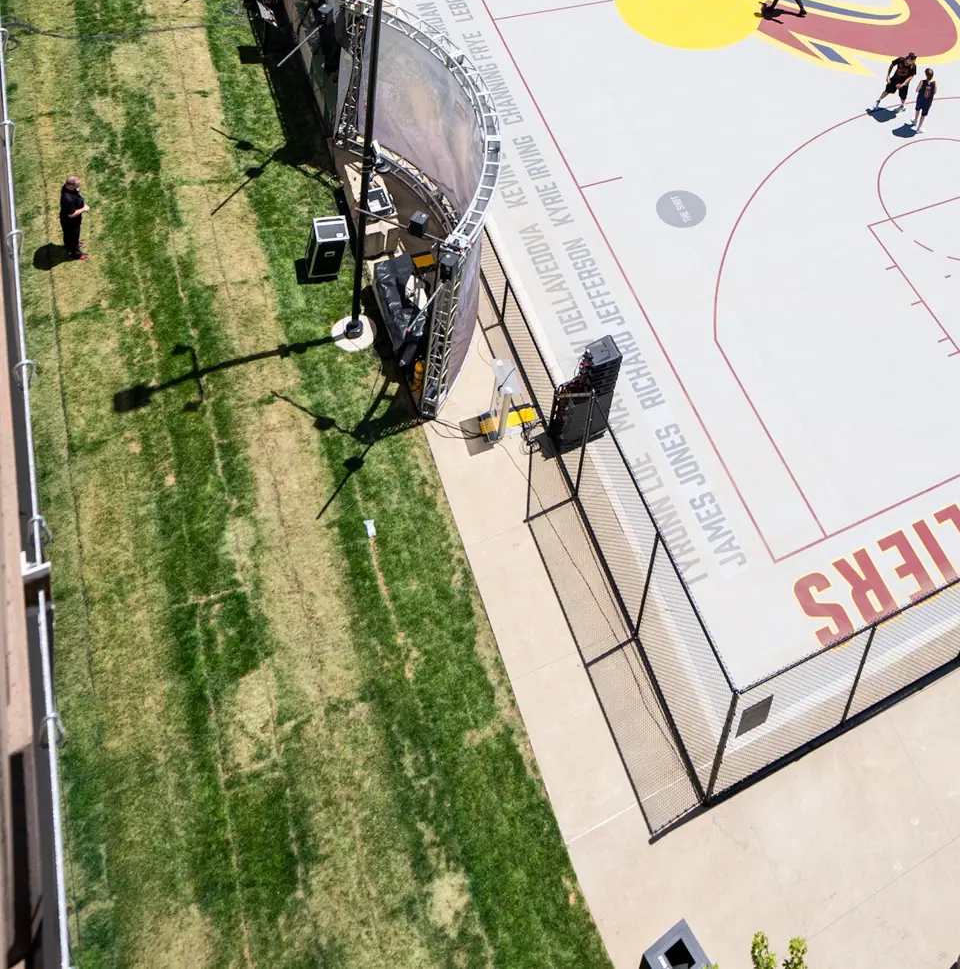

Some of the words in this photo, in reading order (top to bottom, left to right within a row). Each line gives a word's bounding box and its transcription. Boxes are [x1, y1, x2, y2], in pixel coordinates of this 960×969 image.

[462, 31, 493, 61] FRYE
[477, 62, 524, 126] CHANNING
[513, 134, 551, 181] IRVING
[535, 181, 574, 227] KYRIE
[518, 222, 589, 336] DELLAVEDOVA
[562, 236, 625, 327] JEFFERSON
[613, 331, 666, 411] RICHARD
[634, 451, 664, 495] LUE
[655, 423, 706, 486] JONES
[689, 491, 748, 567] JAMES
